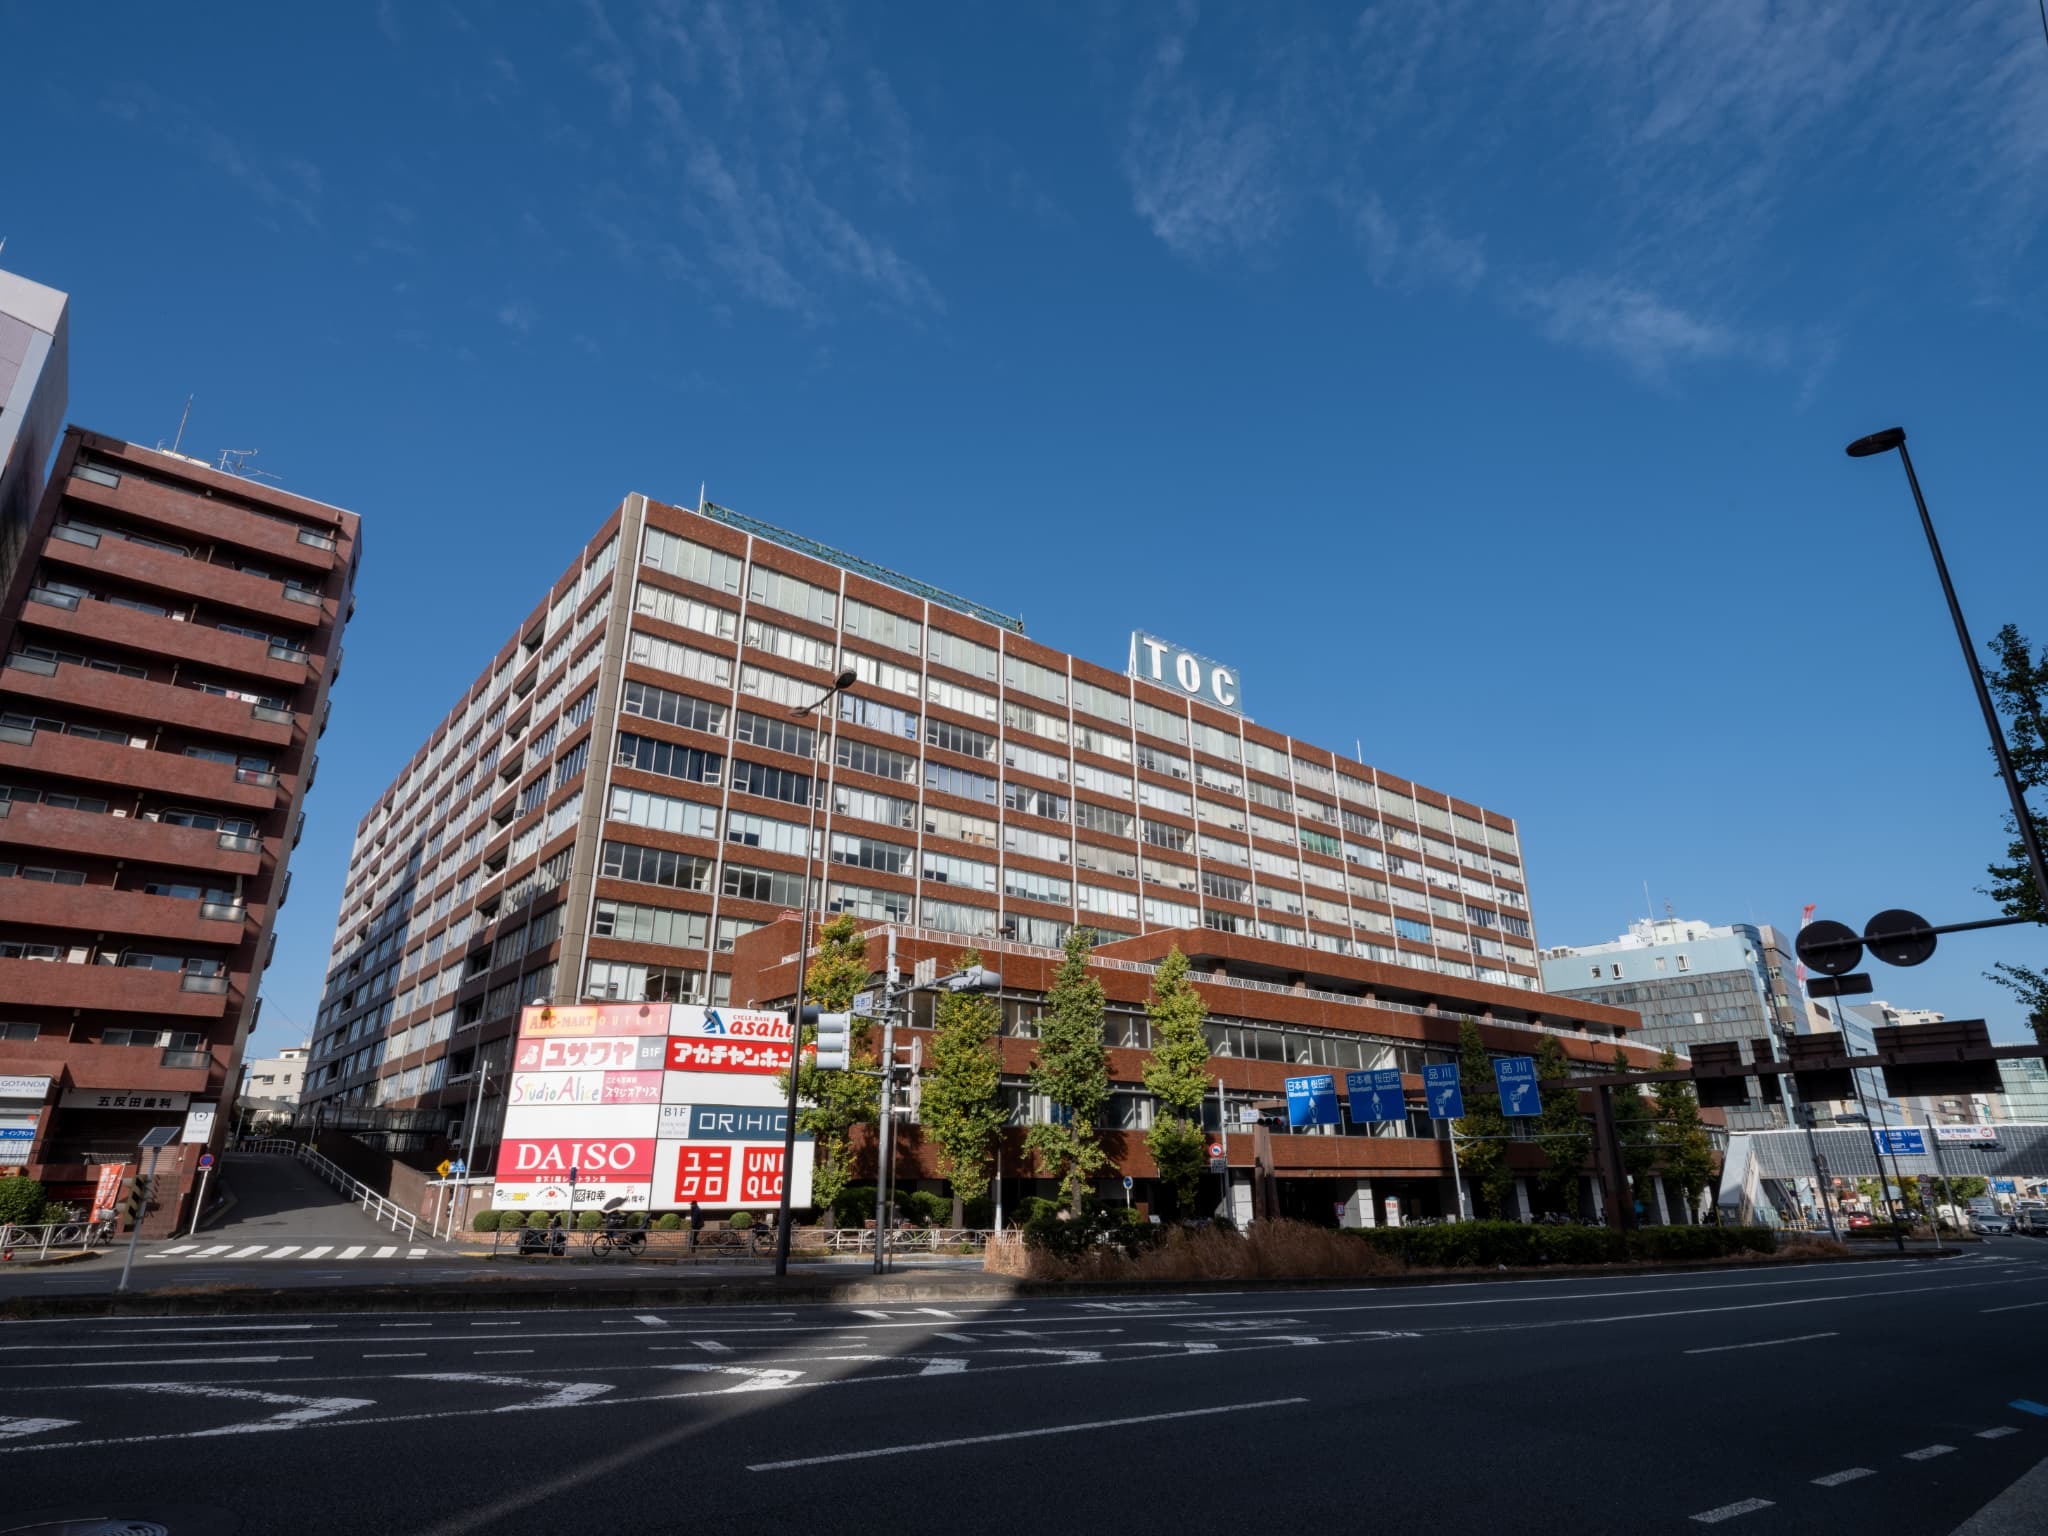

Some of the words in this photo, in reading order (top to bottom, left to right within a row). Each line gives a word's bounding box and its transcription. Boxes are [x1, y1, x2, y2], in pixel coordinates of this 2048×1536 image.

[1143, 637, 1235, 706] TOC
[1428, 1067, 1452, 1080] 品川
[1501, 1061, 1528, 1074] 品川
[1, 1080, 46, 1088] GOTANDA
[513, 1075, 557, 1103] Studio
[557, 1076, 599, 1101] Alice
[98, 1096, 172, 1108] 五反田歯科
[699, 1113, 800, 1133] ORIHIC
[515, 1143, 636, 1170] DAISO
[685, 1152, 723, 1171] ユニ
[748, 1153, 784, 1172] UNI
[681, 1176, 723, 1196] クロ
